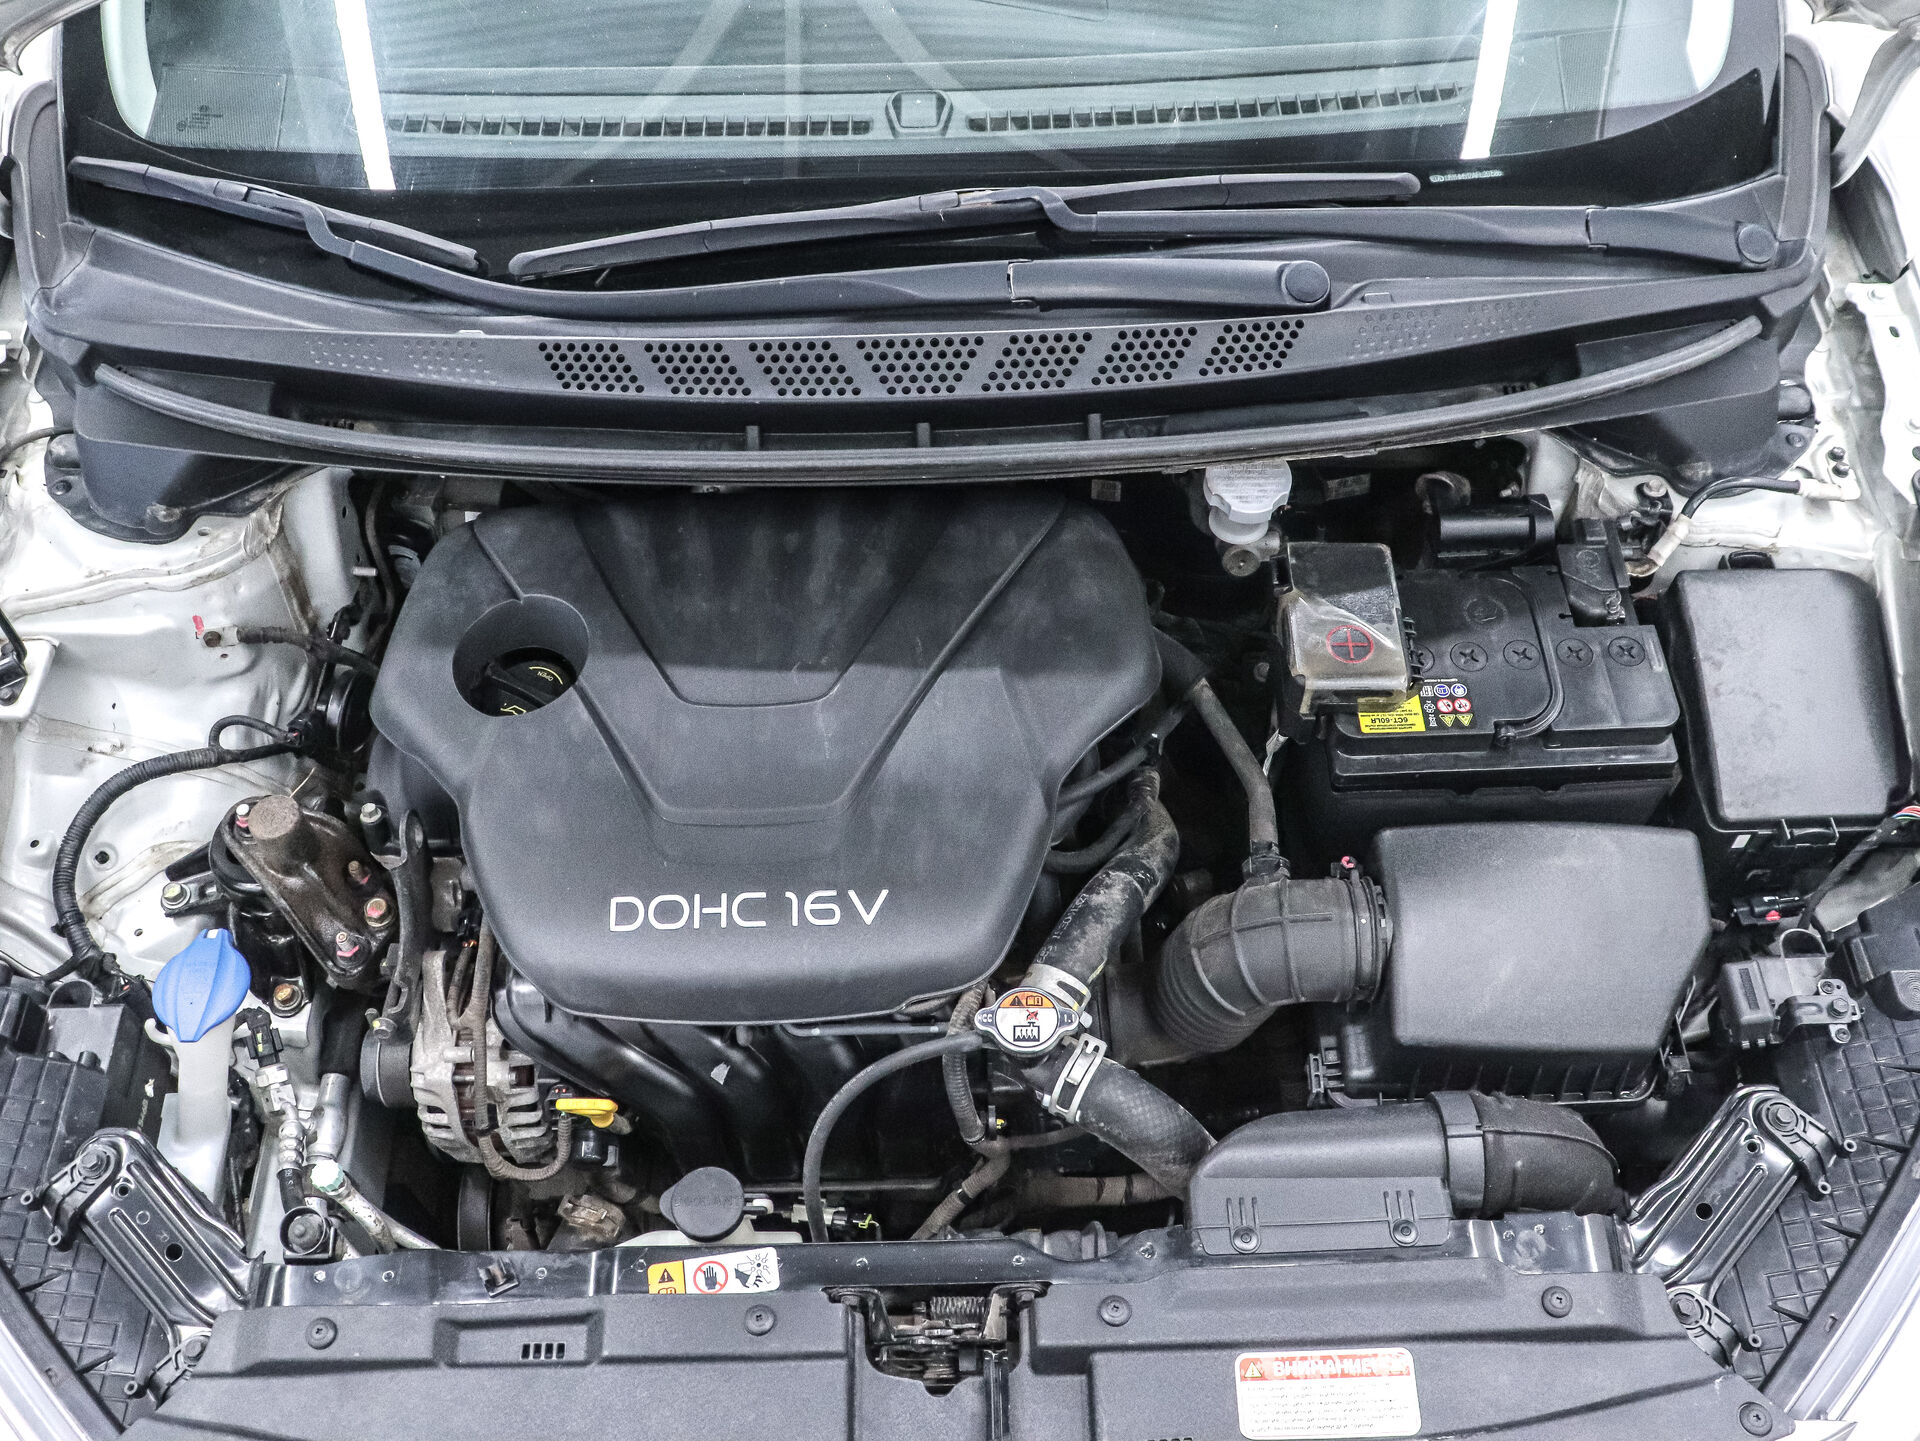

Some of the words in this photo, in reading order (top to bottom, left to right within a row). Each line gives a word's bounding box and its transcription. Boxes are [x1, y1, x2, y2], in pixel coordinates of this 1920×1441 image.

[537, 671, 554, 682] OPEN
[609, 891, 767, 932] DOHC
[1063, 1013, 1075, 1023] 1.1
